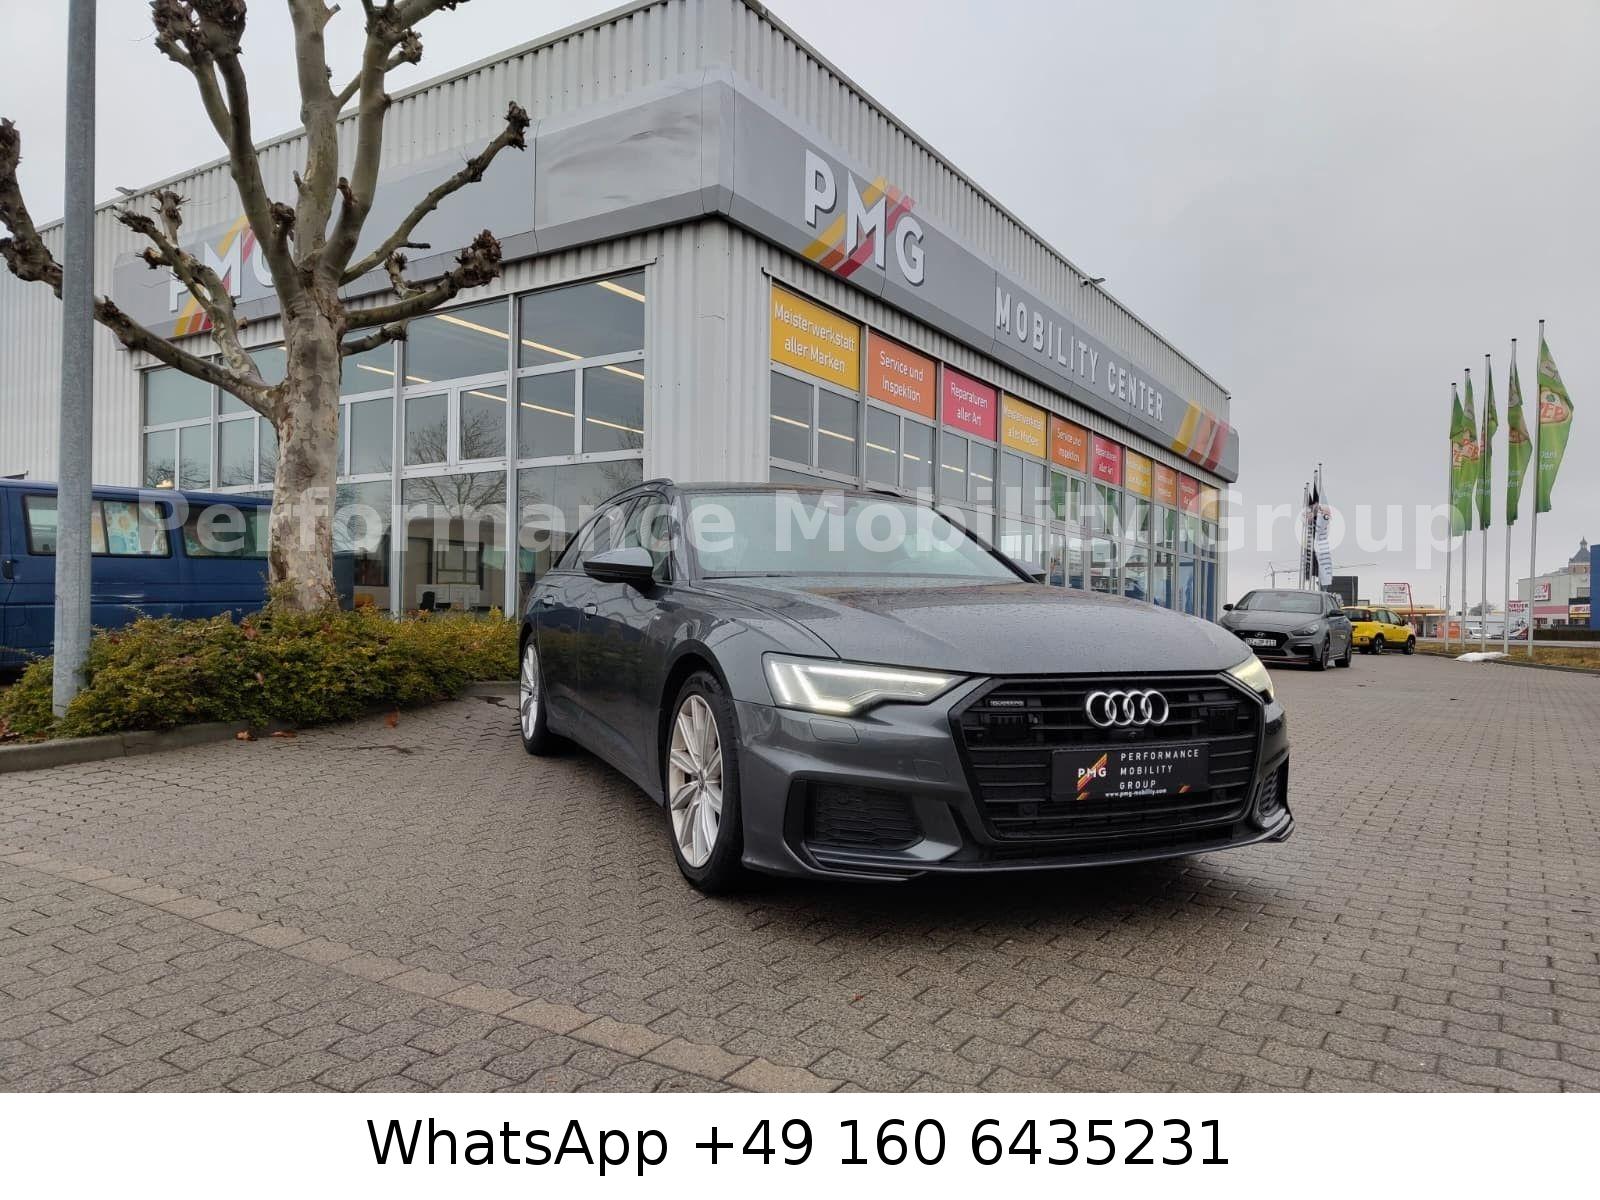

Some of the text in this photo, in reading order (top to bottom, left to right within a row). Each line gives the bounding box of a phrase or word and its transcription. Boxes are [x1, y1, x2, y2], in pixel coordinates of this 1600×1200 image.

[805, 149, 925, 286] PMG
[774, 303, 856, 352] Meisterwerkstatt
[784, 336, 846, 373] aller Marken
[879, 351, 923, 382] Service und
[996, 287, 1163, 421] MOBILITY CENTER
[882, 375, 921, 403] Inspektion
[951, 382, 988, 408] Reparaturen
[956, 407, 982, 426] aller Art
[1120, 749, 1199, 761] PERFORMANCE
[1077, 767, 1107, 778] PMG
[1120, 765, 1173, 776] MOBILITY
[1119, 780, 1156, 790] GROUP
